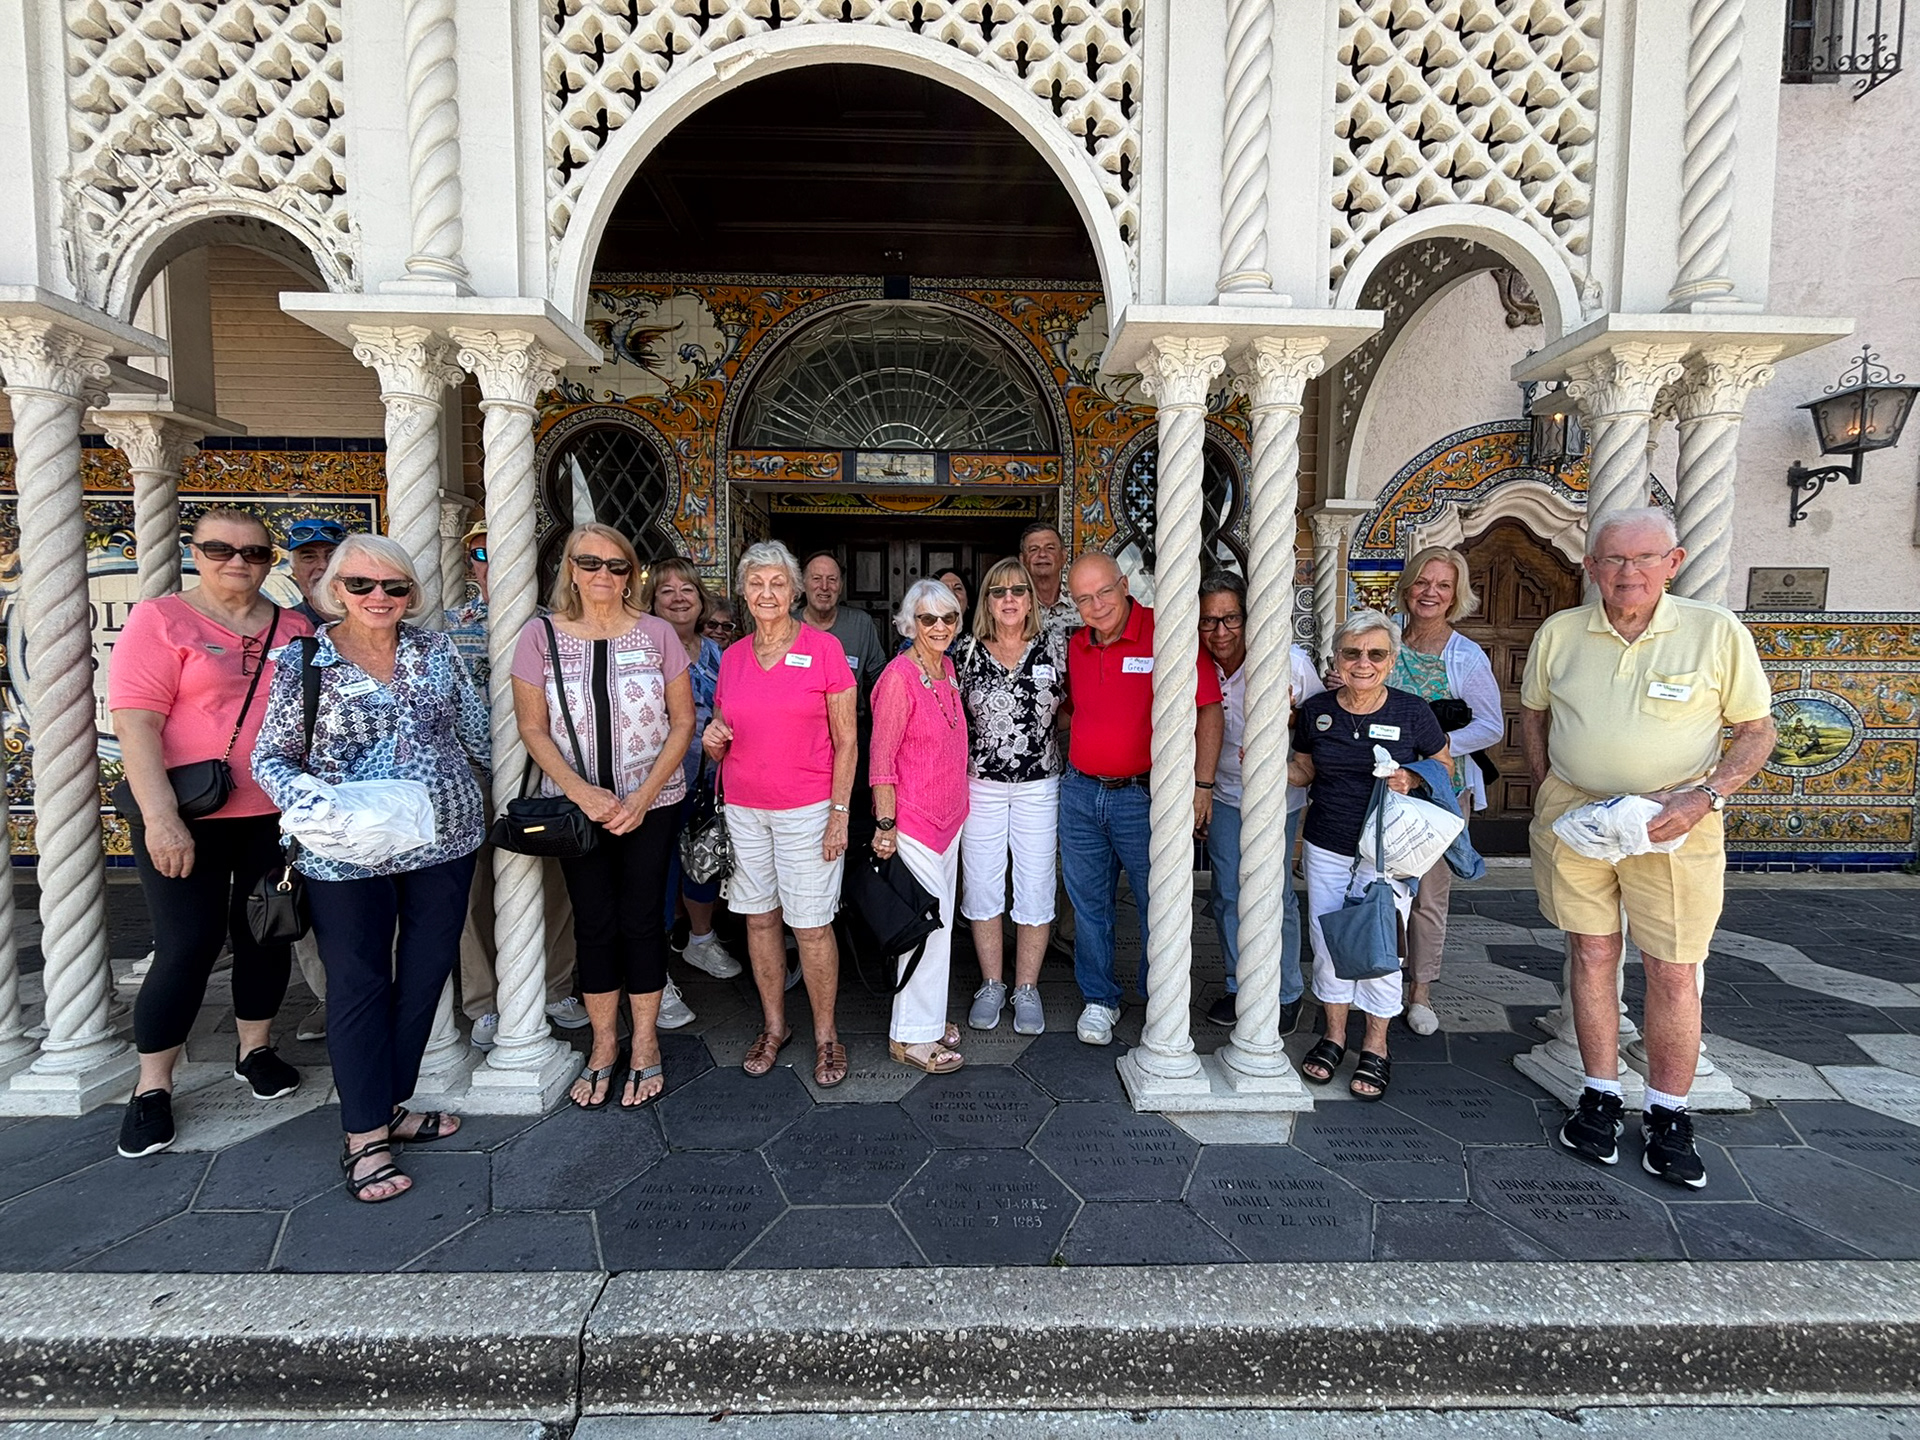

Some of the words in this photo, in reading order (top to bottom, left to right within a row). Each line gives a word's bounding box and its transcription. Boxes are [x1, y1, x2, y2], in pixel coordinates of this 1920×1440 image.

[1122, 1128, 1172, 1138] MEMORY
[1211, 1179, 1262, 1189] LOVING
[1268, 1179, 1326, 1190] MEMORY
[1491, 1179, 1545, 1190] LOVING
[1545, 1180, 1606, 1191] MEMORY
[1221, 1195, 1273, 1207] DANIEL
[1279, 1196, 1331, 1208] SUAREZ
[1530, 1208, 1569, 1220] 1954
[1012, 1215, 1043, 1228] 1983
